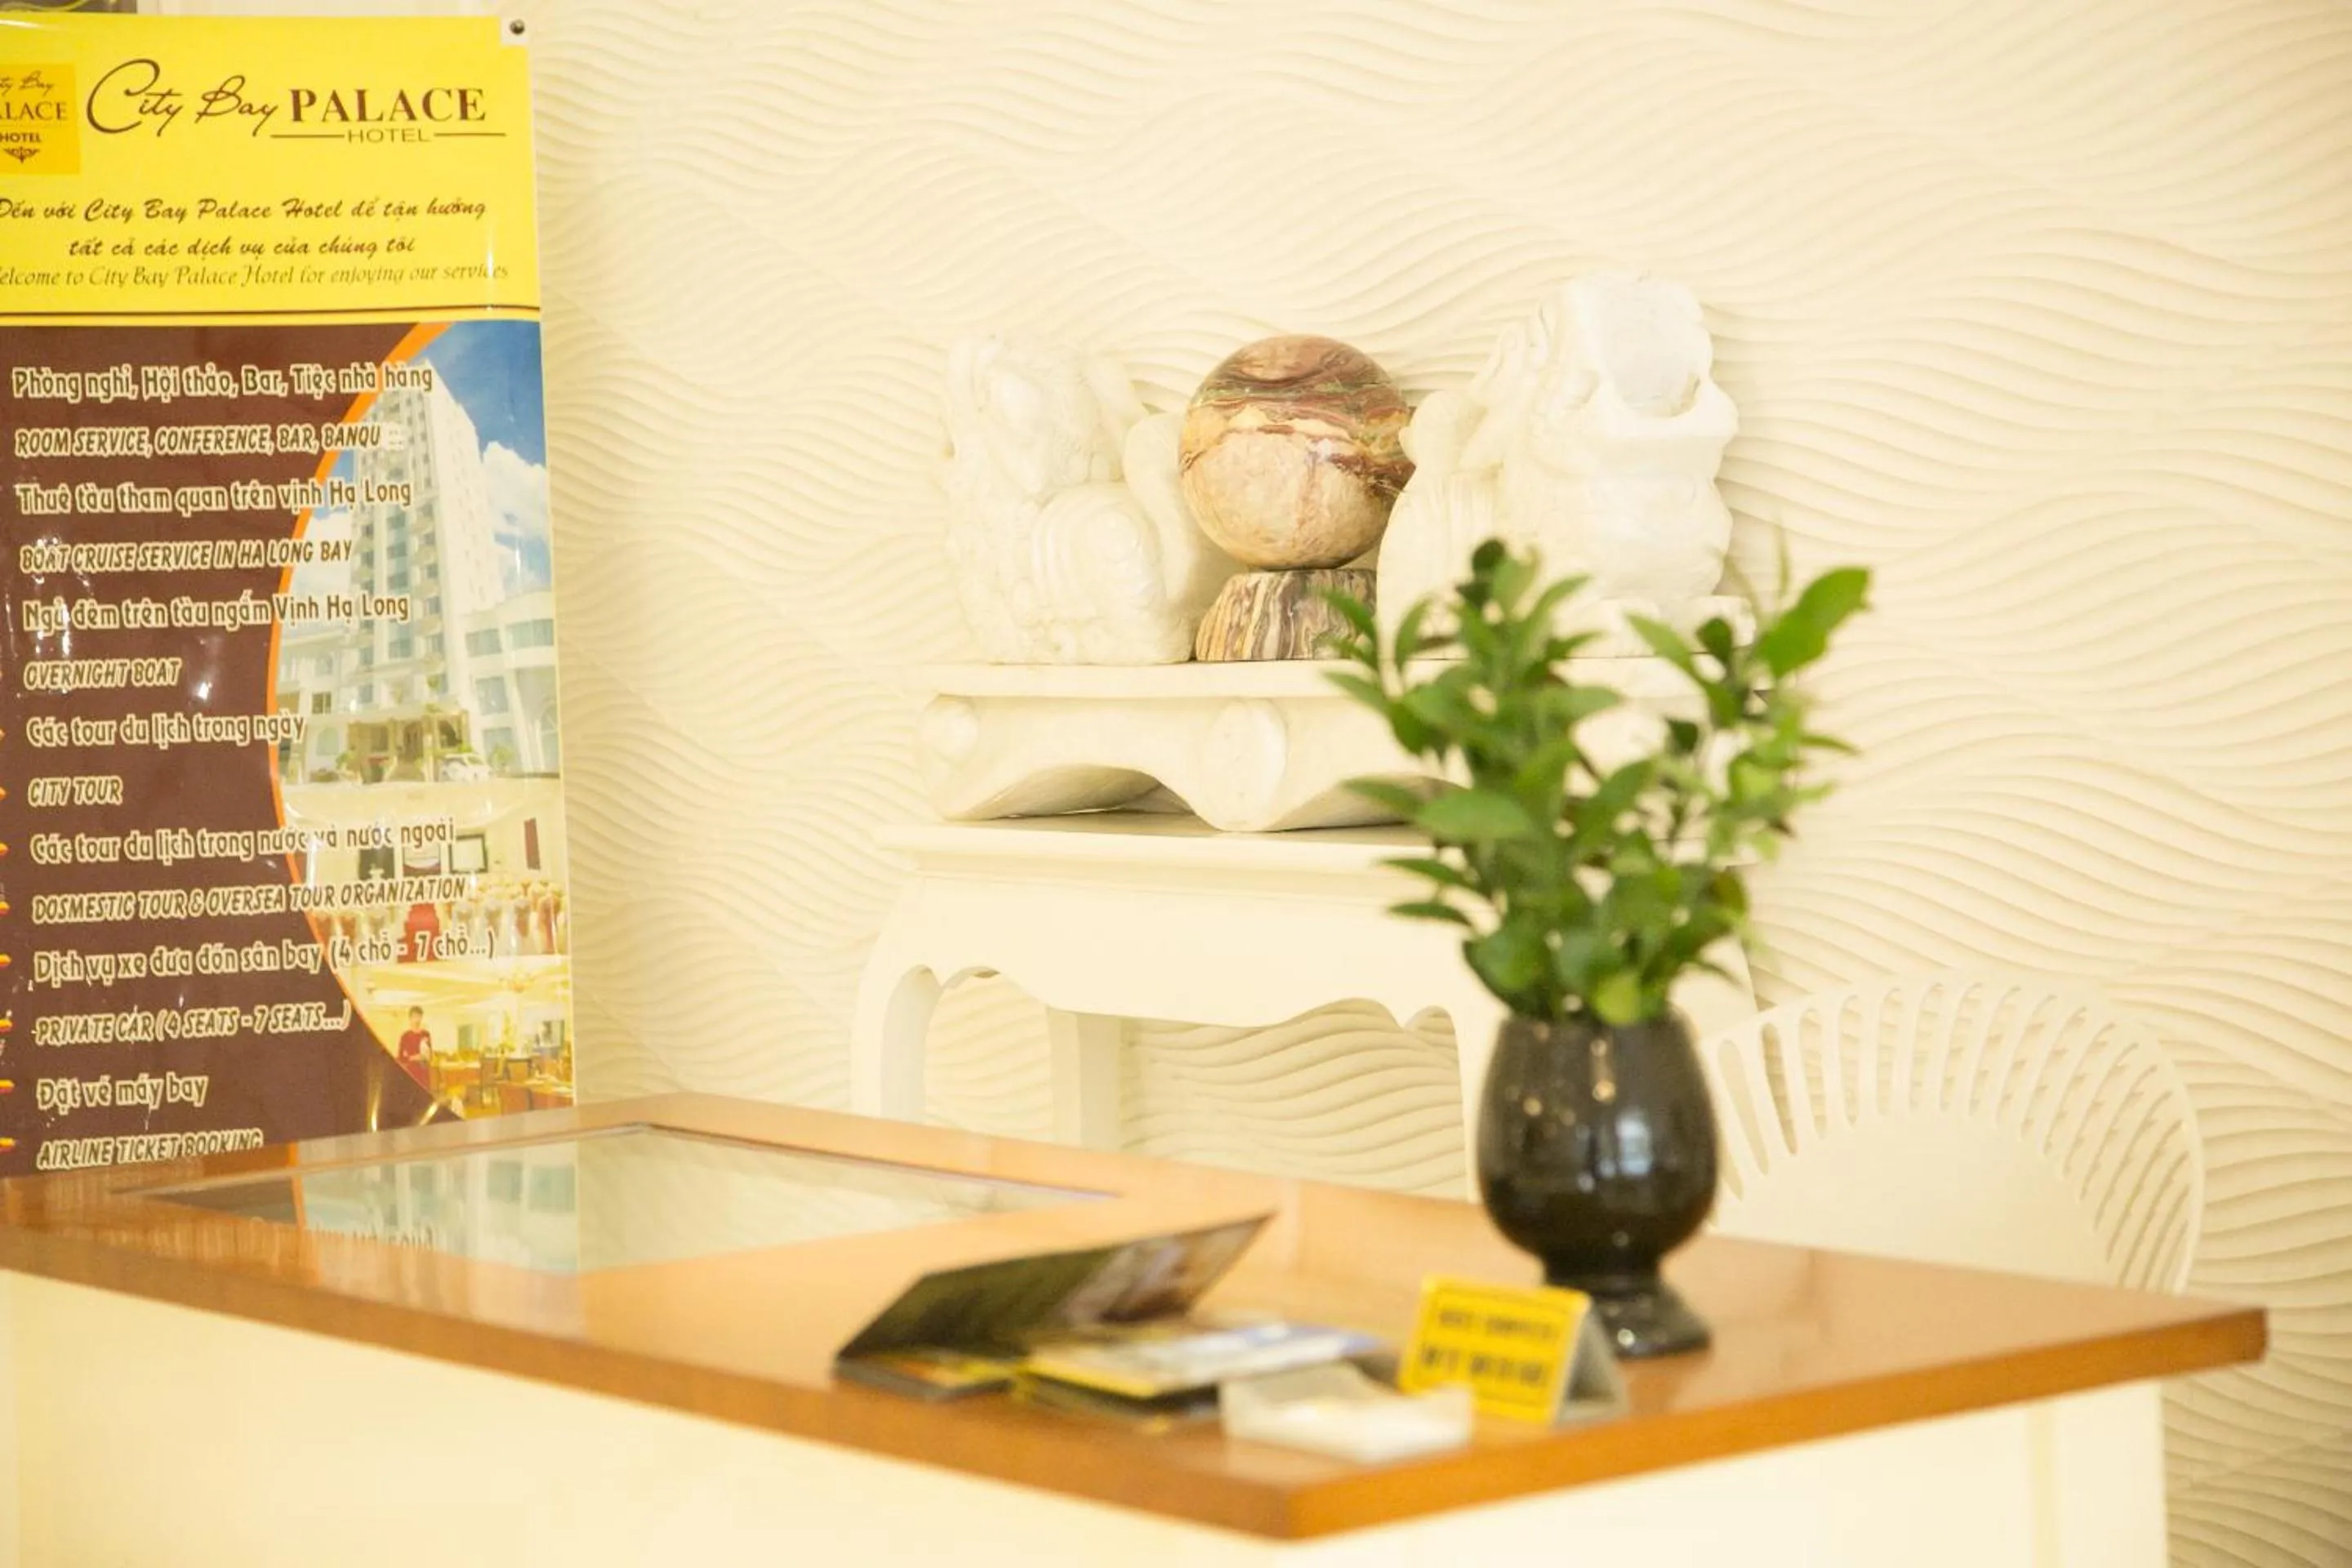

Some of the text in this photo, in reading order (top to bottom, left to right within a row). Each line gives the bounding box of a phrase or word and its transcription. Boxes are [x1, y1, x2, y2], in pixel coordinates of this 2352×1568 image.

[0, 100, 68, 122] LACE
[87, 58, 486, 137] City Bay PALACE
[347, 128, 431, 144] HOTEL
[84, 198, 135, 224] City
[144, 198, 188, 224] Bay
[197, 198, 271, 220] Palace
[281, 198, 344, 219] Hotel
[110, 236, 135, 256] cả
[144, 238, 180, 256] các
[239, 242, 265, 261] vụ
[385, 237, 416, 252] tôi
[0, 265, 59, 286] elcome
[65, 270, 84, 286] to
[88, 265, 128, 288] City
[132, 265, 168, 288] Bay
[175, 265, 238, 286] Palace
[240, 263, 294, 287] Hotel
[299, 265, 325, 284] for
[330, 266, 405, 286] enjoying
[408, 266, 439, 281] our
[12, 367, 82, 403] Phòng
[242, 364, 288, 397] Bar,
[340, 361, 378, 394] nhà
[384, 361, 434, 392] hàng
[15, 428, 71, 458] ROOM
[73, 426, 153, 458] SERVICE,
[155, 424, 274, 455] CONFERENCE,
[276, 422, 319, 455] BAR,
[16, 483, 72, 514] Thuê
[75, 482, 115, 513] tàu
[117, 482, 172, 513] tham
[175, 487, 229, 518] quan
[230, 479, 275, 510] trên
[363, 477, 413, 507] Long
[20, 537, 354, 574] BOAT CRUISE SERVICE IN HA LONG BAY
[122, 598, 169, 628] trên
[171, 596, 208, 627] tàu
[360, 593, 410, 621] Long
[24, 657, 181, 690] OVERNIGHT BOAT
[70, 715, 118, 746] tour
[119, 713, 149, 745] du
[193, 711, 250, 746] trong
[27, 776, 123, 807] CITY TOUR
[74, 832, 121, 862] tour
[123, 829, 154, 861] du
[197, 827, 252, 862] trong
[32, 875, 467, 924] DOSMESTIC TOUR & OVERSEA TOUR ORGANIZATION
[118, 952, 147, 979] xe
[241, 940, 279, 972] sân
[283, 938, 323, 974] bay
[328, 937, 352, 973] (4
[413, 930, 430, 962] 7
[35, 1013, 114, 1046] PRIVATE
[115, 1009, 154, 1042] CAR
[181, 1006, 240, 1039] SEATS
[253, 1004, 268, 1034] 7
[165, 1071, 208, 1107] bay
[37, 1128, 264, 1170] AIRLINE TICKET BOOKING
